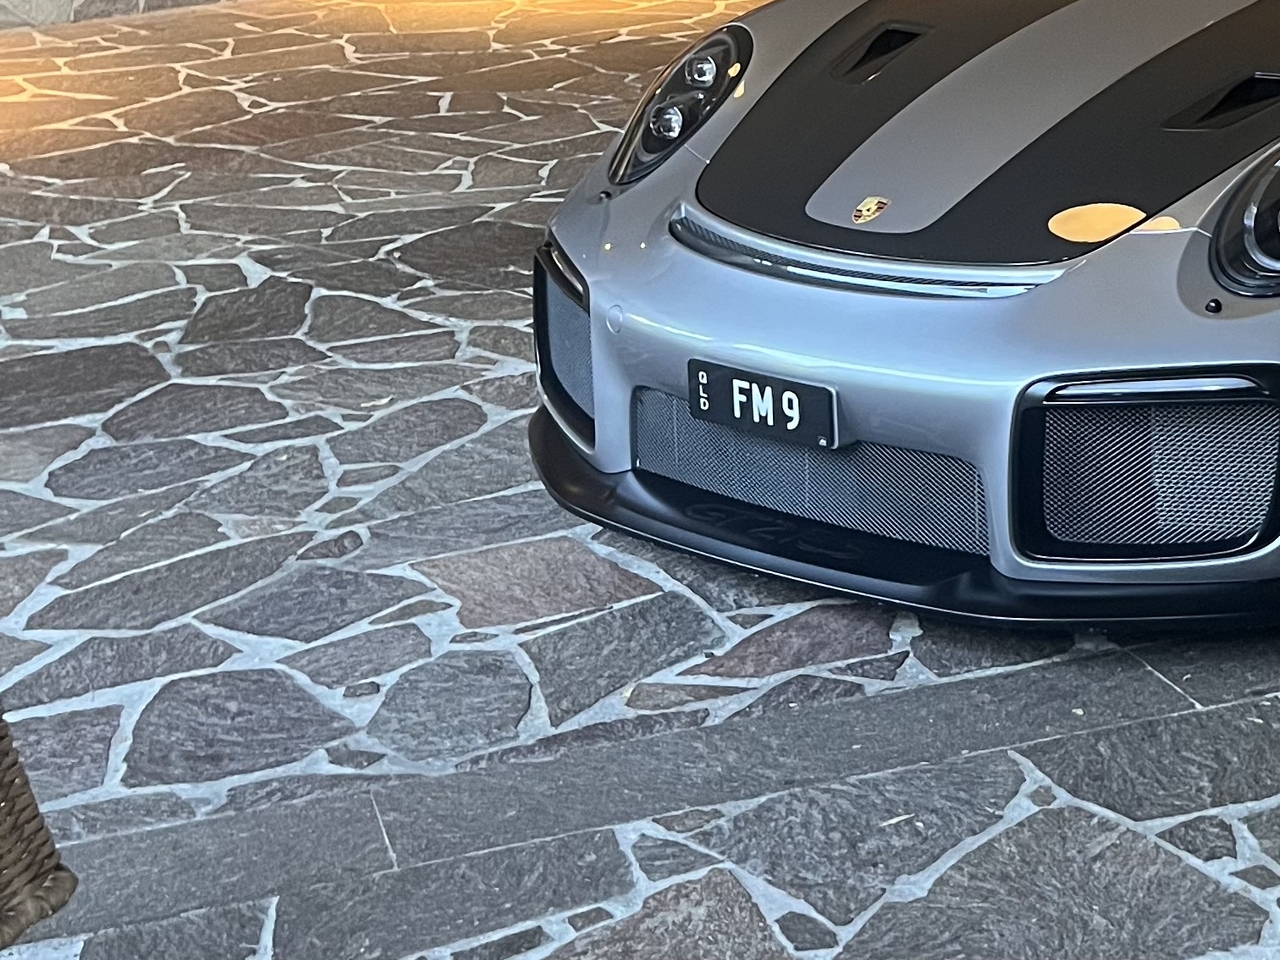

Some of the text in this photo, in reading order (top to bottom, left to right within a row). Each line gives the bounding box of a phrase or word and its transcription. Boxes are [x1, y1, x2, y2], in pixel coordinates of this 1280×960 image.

[698, 371, 710, 411] QLD
[732, 378, 801, 431] FM 9
